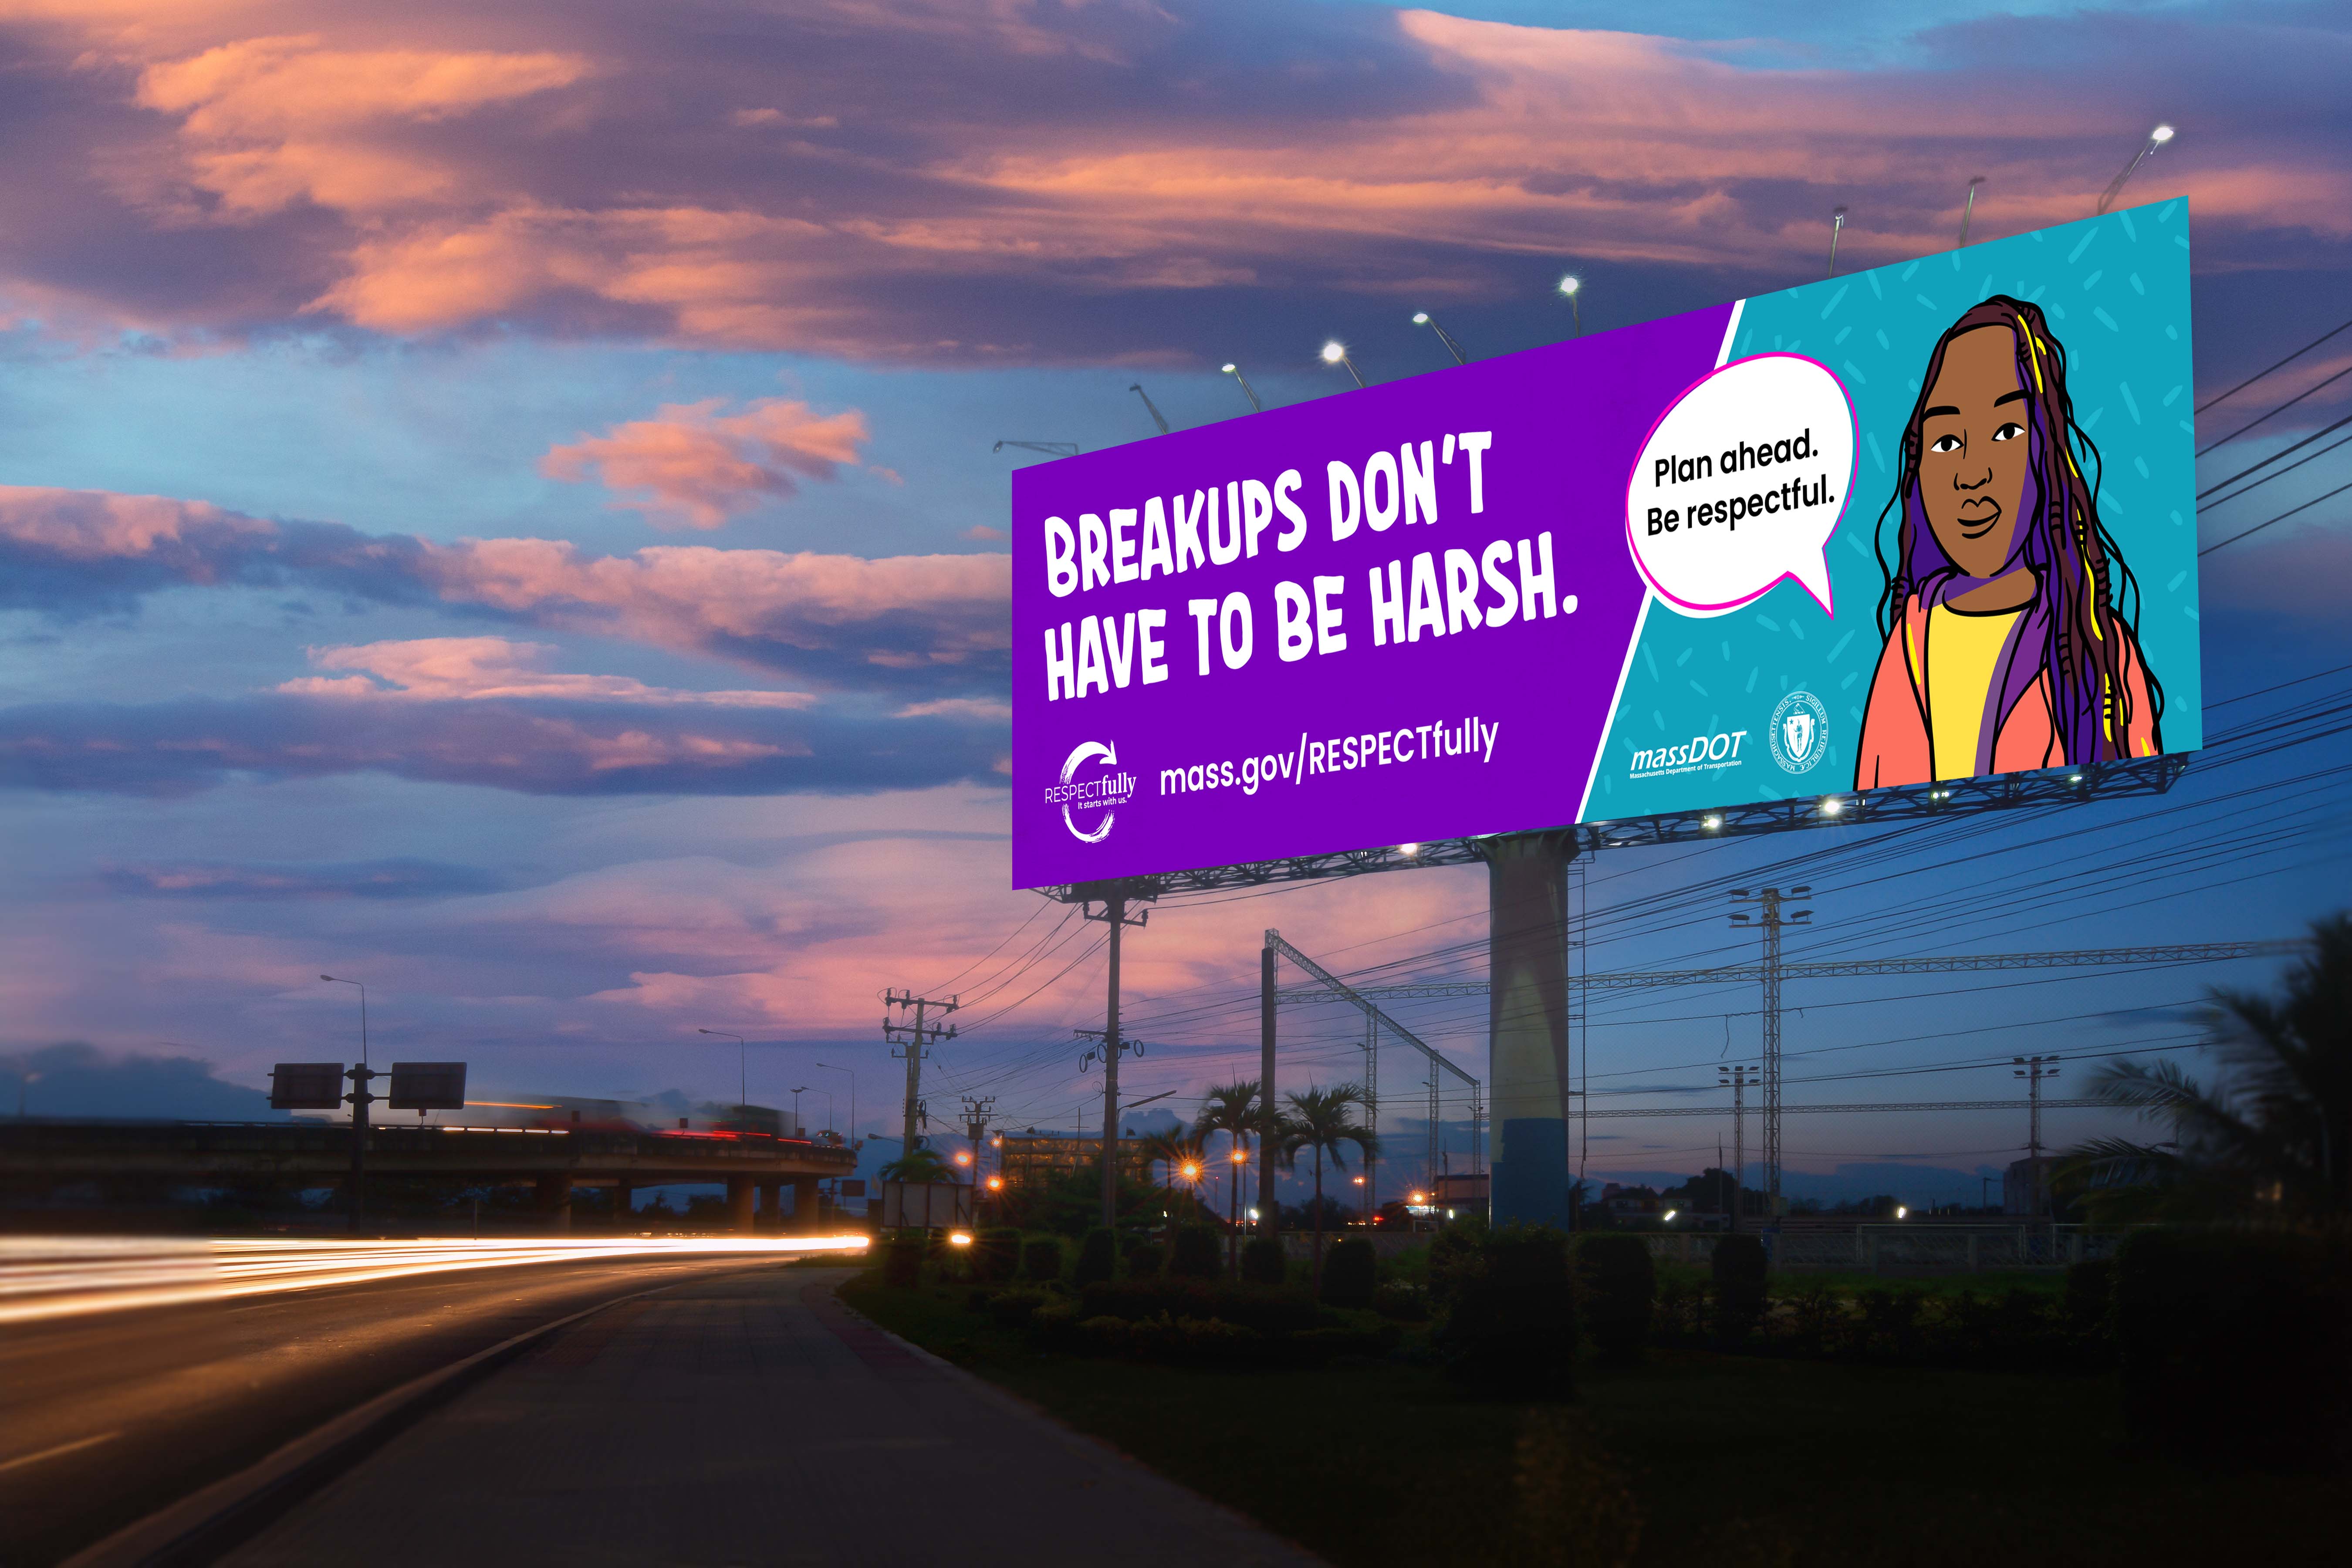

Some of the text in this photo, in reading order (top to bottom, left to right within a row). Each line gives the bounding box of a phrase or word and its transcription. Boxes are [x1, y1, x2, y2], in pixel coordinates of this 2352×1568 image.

[1655, 428, 1818, 487] Plan ahead.
[1044, 431, 1492, 598] BREAKUPS DON'T
[1648, 473, 1835, 536] Be respectful.
[1044, 531, 1578, 702] HAVE TO BE HARSH.
[1805, 695, 1826, 725] SIGILLUM
[1161, 716, 1499, 795] mass.gov/RESPECTfully
[1629, 770, 1665, 779] Massachusetts
[1666, 766, 1696, 775] Department
[1703, 760, 1742, 770] Transportation
[1630, 730, 1747, 771] massDOT
[1045, 772, 1137, 804] RESPECTfully
[1084, 800, 1102, 809] starts
[1102, 797, 1117, 806] with
